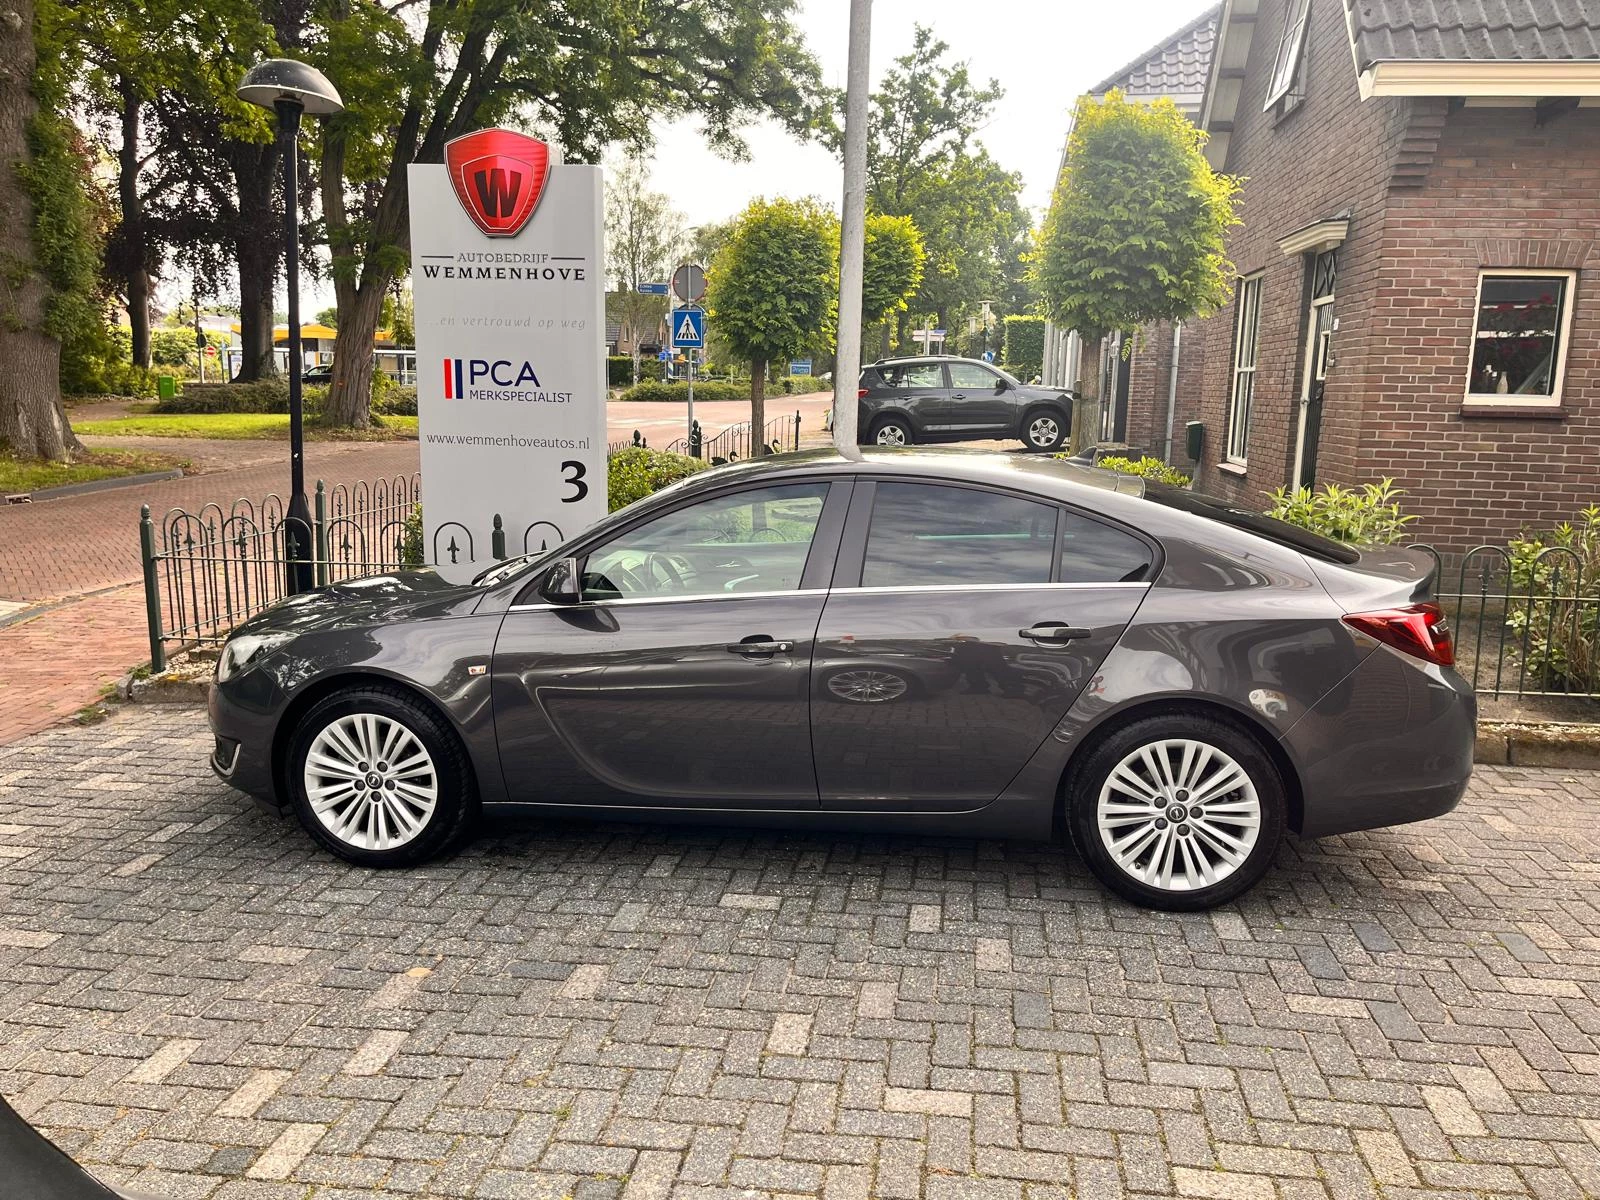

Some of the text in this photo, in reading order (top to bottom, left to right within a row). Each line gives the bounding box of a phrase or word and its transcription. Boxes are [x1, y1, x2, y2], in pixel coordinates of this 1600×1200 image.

[474, 168, 522, 218] W
[457, 253, 549, 264] AUTOBEDRIJF
[422, 265, 585, 281] WEMMENHOVE
[462, 315, 531, 328] vertrouwd
[538, 318, 554, 330] op
[560, 318, 586, 331] weg
[469, 359, 541, 388] PCA
[469, 390, 573, 404] MERKSPECIALIST
[426, 434, 590, 450] www.wemmenhoveautos.nl
[560, 460, 589, 504] 3
